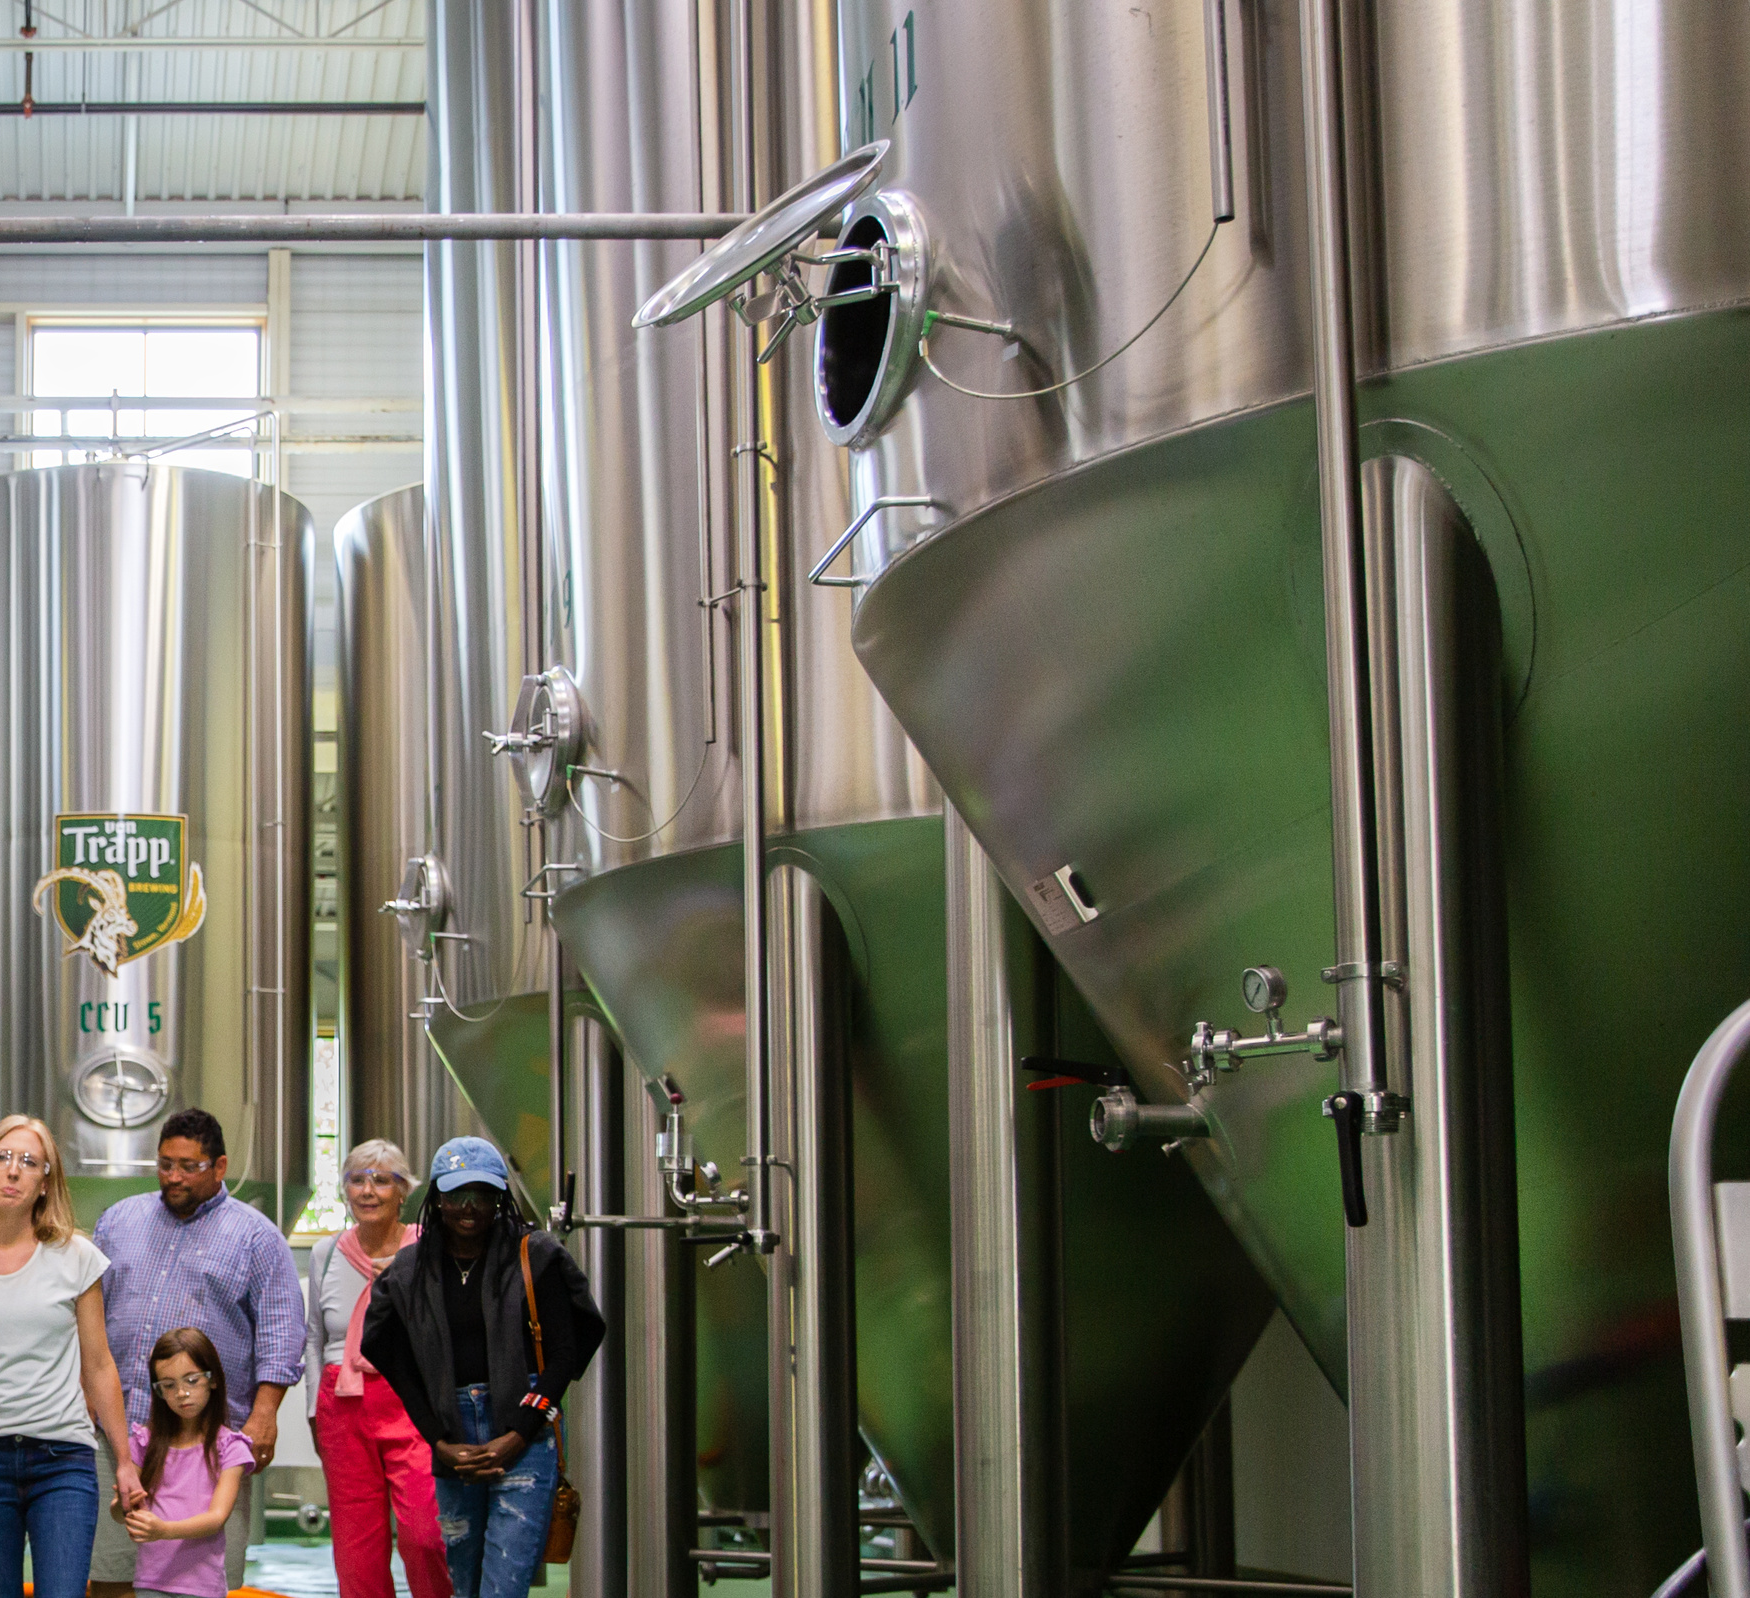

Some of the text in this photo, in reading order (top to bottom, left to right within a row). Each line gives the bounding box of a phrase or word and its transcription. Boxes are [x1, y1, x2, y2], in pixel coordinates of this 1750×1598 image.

[104, 821, 137, 834] von
[62, 825, 170, 878] Trapp
[128, 882, 178, 894] BREWING
[81, 1002, 161, 1034] CCU 5
